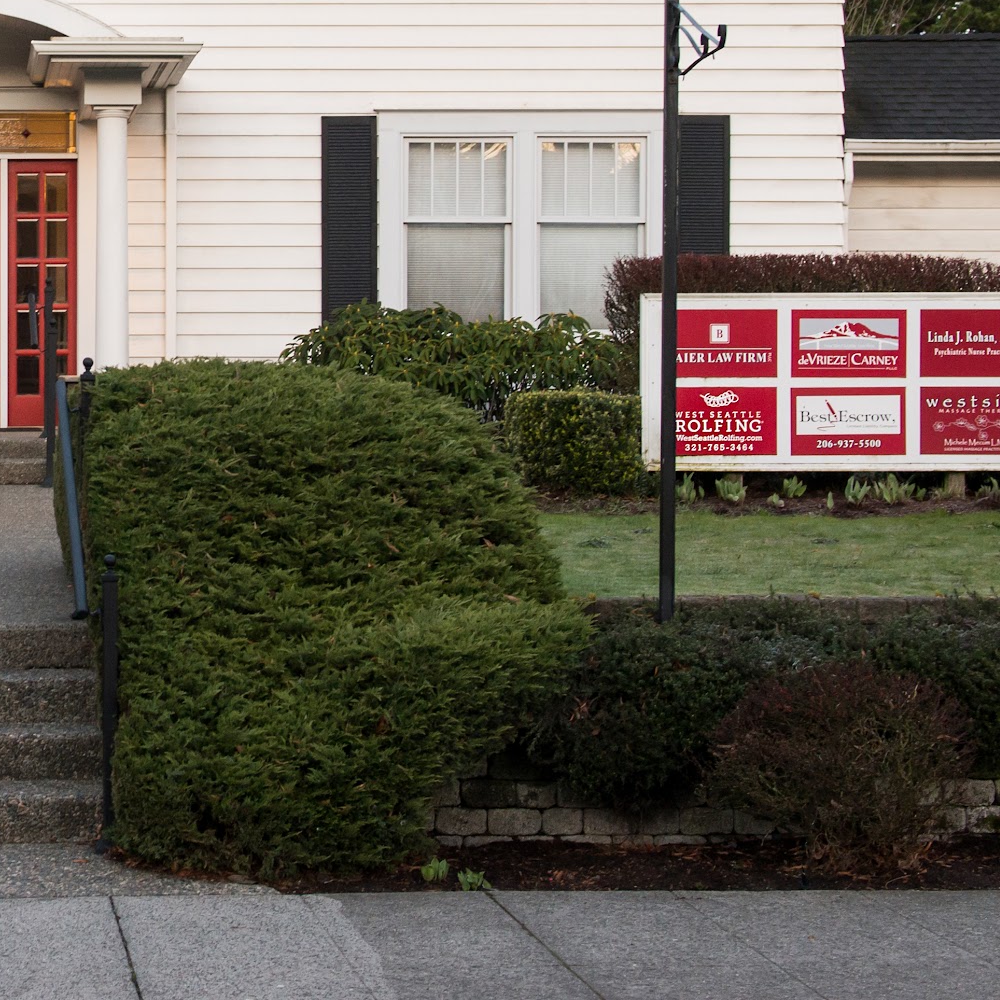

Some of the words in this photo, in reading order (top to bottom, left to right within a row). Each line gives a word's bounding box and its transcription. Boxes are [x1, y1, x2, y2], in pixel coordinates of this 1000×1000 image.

[716, 329, 723, 339] B
[927, 330, 954, 343] Linda
[955, 330, 964, 345] J.
[965, 330, 998, 345] Rohan,
[676, 352, 705, 363] AIER
[708, 352, 734, 363] LAW
[736, 352, 767, 363] FIRM
[934, 347, 967, 358] Psychiatric
[968, 347, 986, 356] Nurse
[850, 352, 899, 366] CARNEY
[675, 411, 705, 419] WEST
[709, 411, 762, 419] SEATTLE
[800, 410, 832, 423] Best
[675, 419, 762, 433] ROLFING
[676, 434, 763, 443] WestSeattleRolfing.com
[816, 439, 882, 449] 206-937-5500
[684, 443, 754, 452] 321-765-3464
